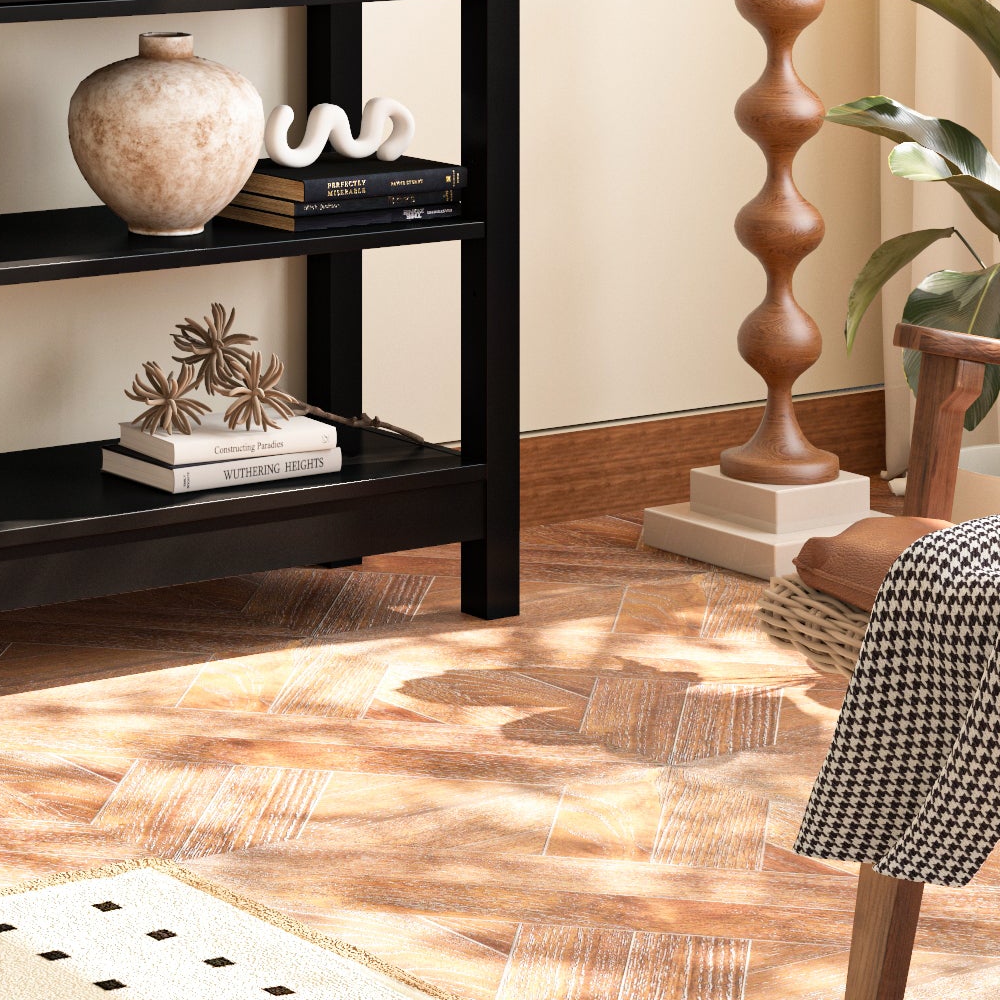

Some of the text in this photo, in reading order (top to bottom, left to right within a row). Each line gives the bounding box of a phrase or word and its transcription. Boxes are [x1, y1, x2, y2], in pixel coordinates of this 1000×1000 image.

[327, 179, 367, 189] PERFECTLY
[214, 443, 256, 455] Constructing
[223, 456, 324, 481] WUTHERING HEIGHTS
